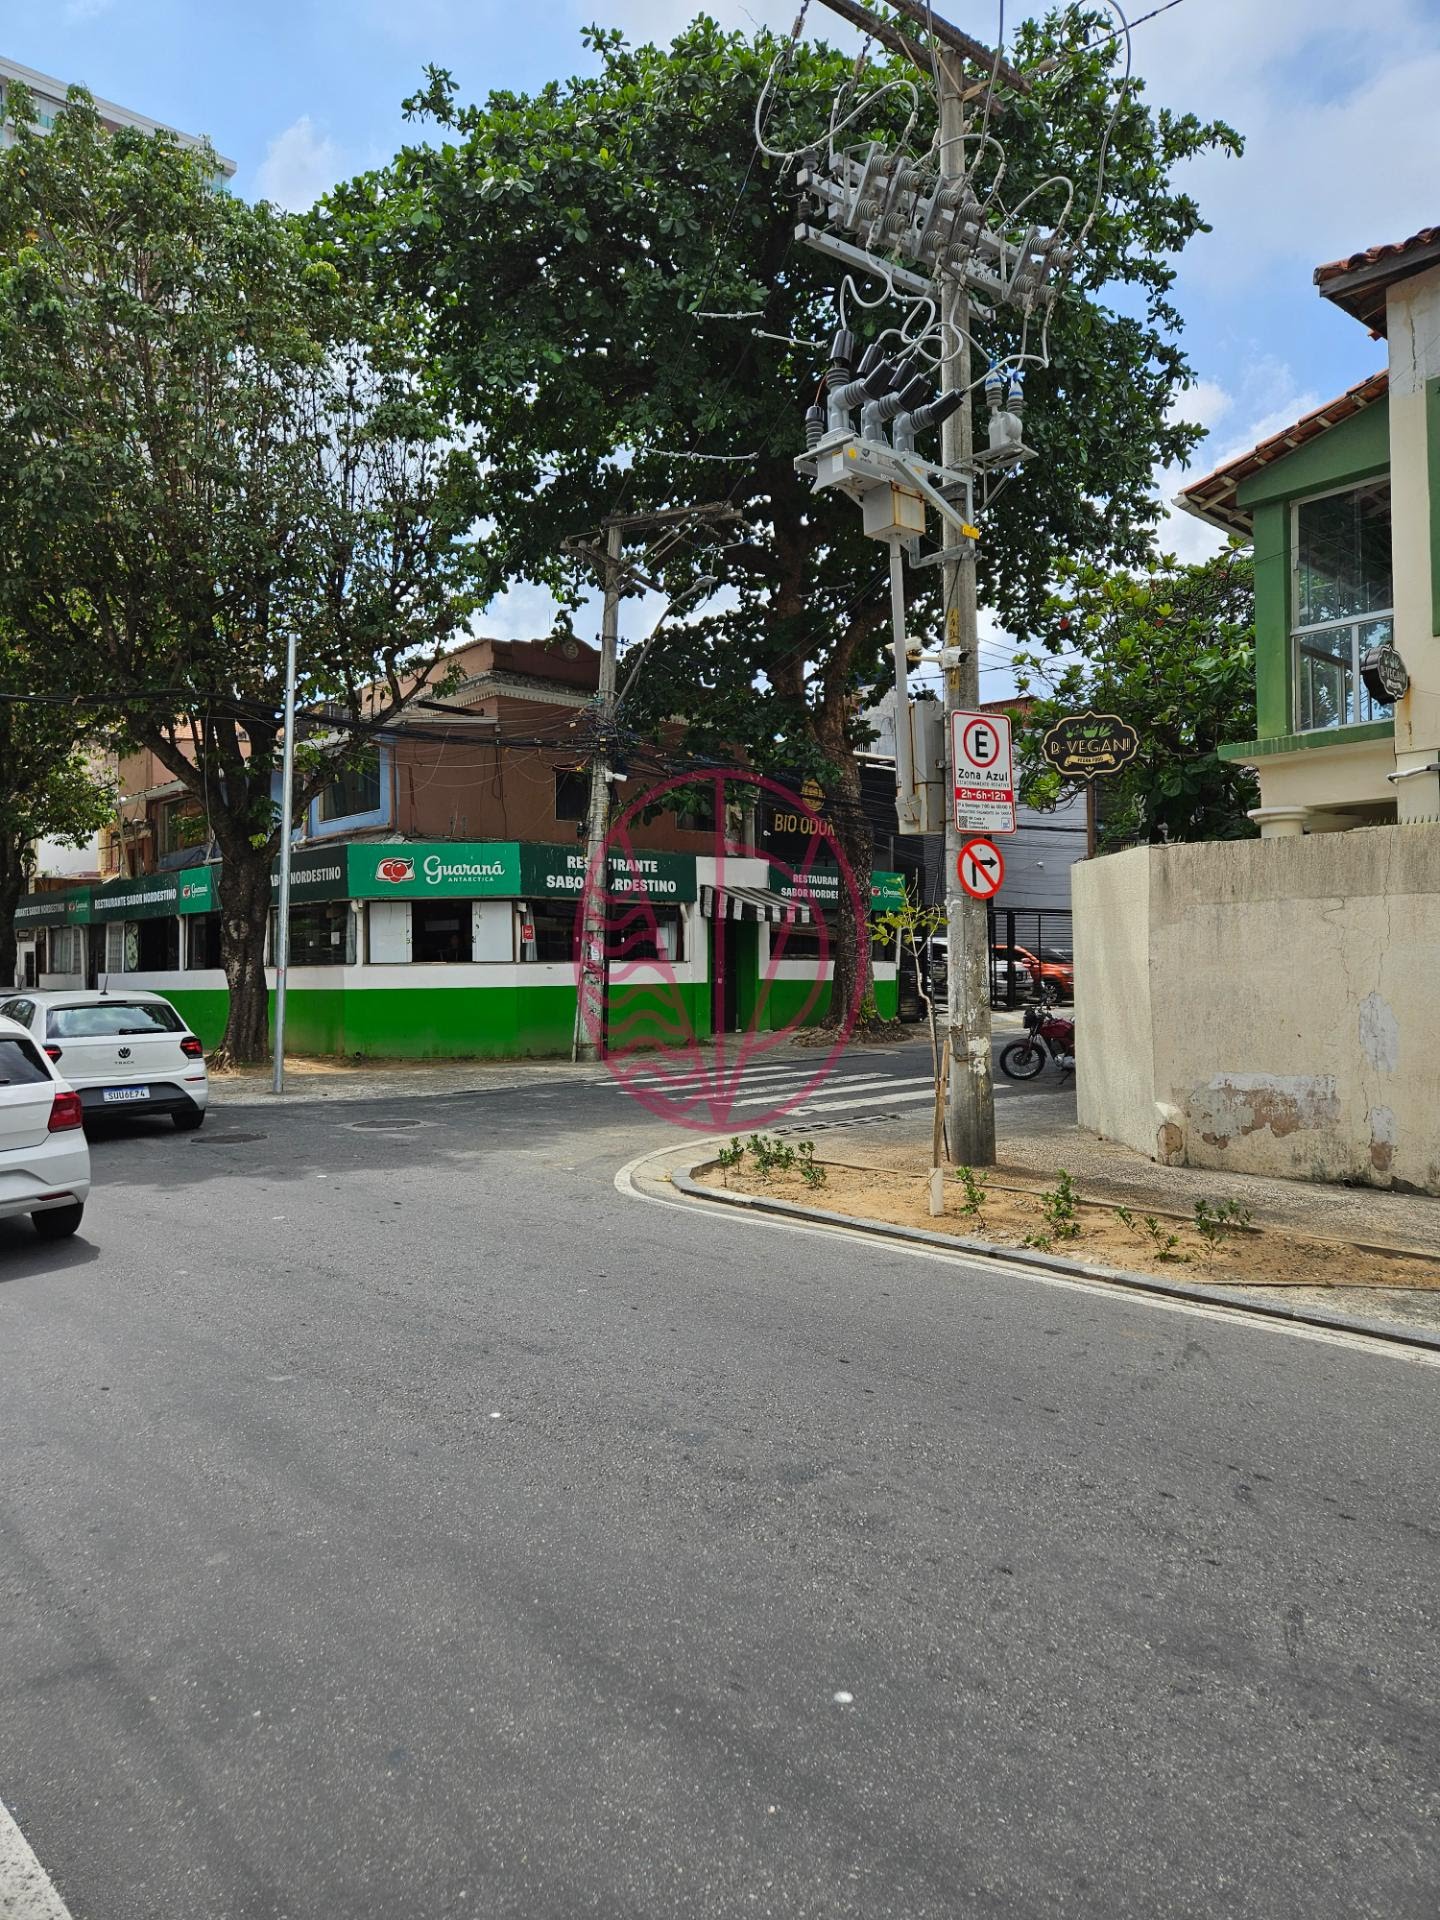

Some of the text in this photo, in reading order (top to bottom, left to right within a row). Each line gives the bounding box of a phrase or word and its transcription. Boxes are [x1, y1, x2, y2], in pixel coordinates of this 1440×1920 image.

[975, 730, 988, 758] E
[958, 768, 1008, 782] Zona Azul
[961, 789, 1006, 801] 2h-6h-12h
[774, 813, 798, 833] BIO
[423, 855, 505, 885] Guaraná
[567, 855, 658, 873] RESURANTE
[290, 866, 341, 885] NORDESTINO
[546, 874, 677, 893] SABO RDESTINO
[793, 874, 839, 886] RESTAURAN
[781, 887, 839, 900] SABOR NORDES
